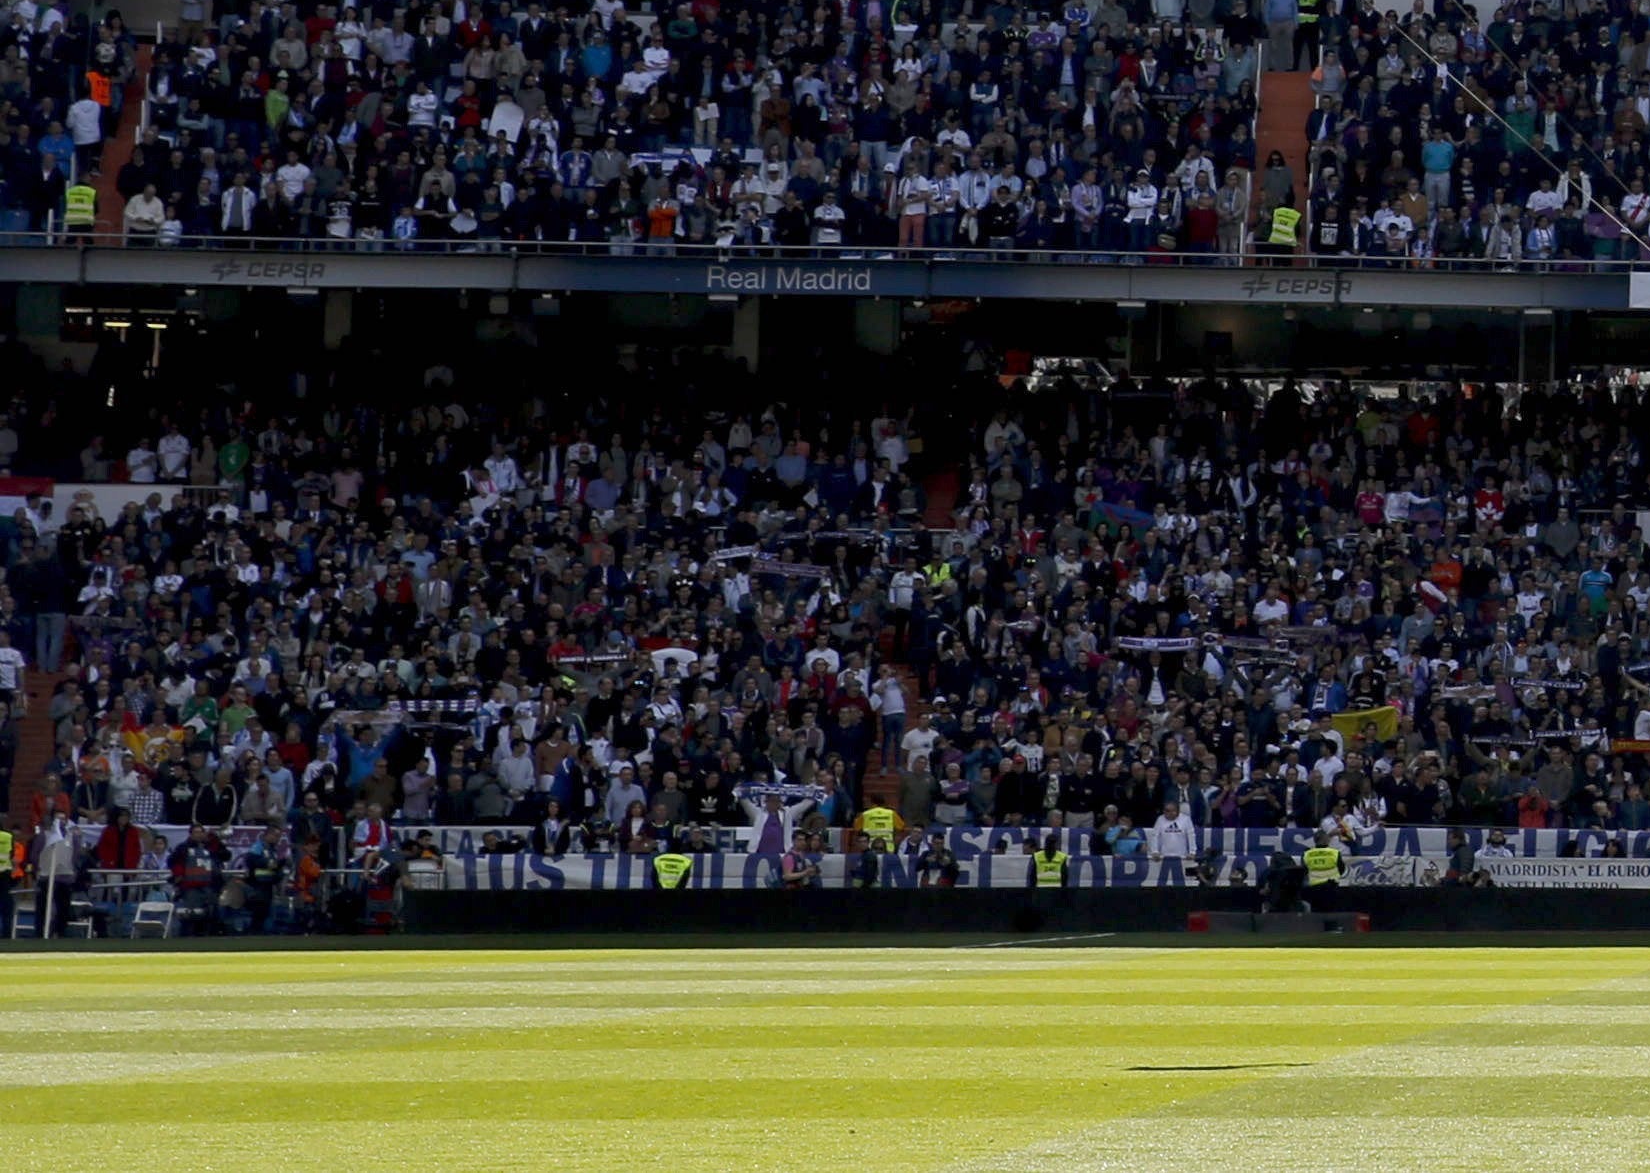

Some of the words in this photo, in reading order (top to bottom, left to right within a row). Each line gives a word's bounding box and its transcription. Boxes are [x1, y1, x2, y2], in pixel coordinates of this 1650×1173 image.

[251, 259, 326, 280] CEPSA
[706, 264, 768, 291] Real
[776, 264, 872, 291] Madrid
[1276, 278, 1351, 297] CEPSA
[455, 853, 566, 890] TUS
[1488, 863, 1577, 877] MADRIDISTA
